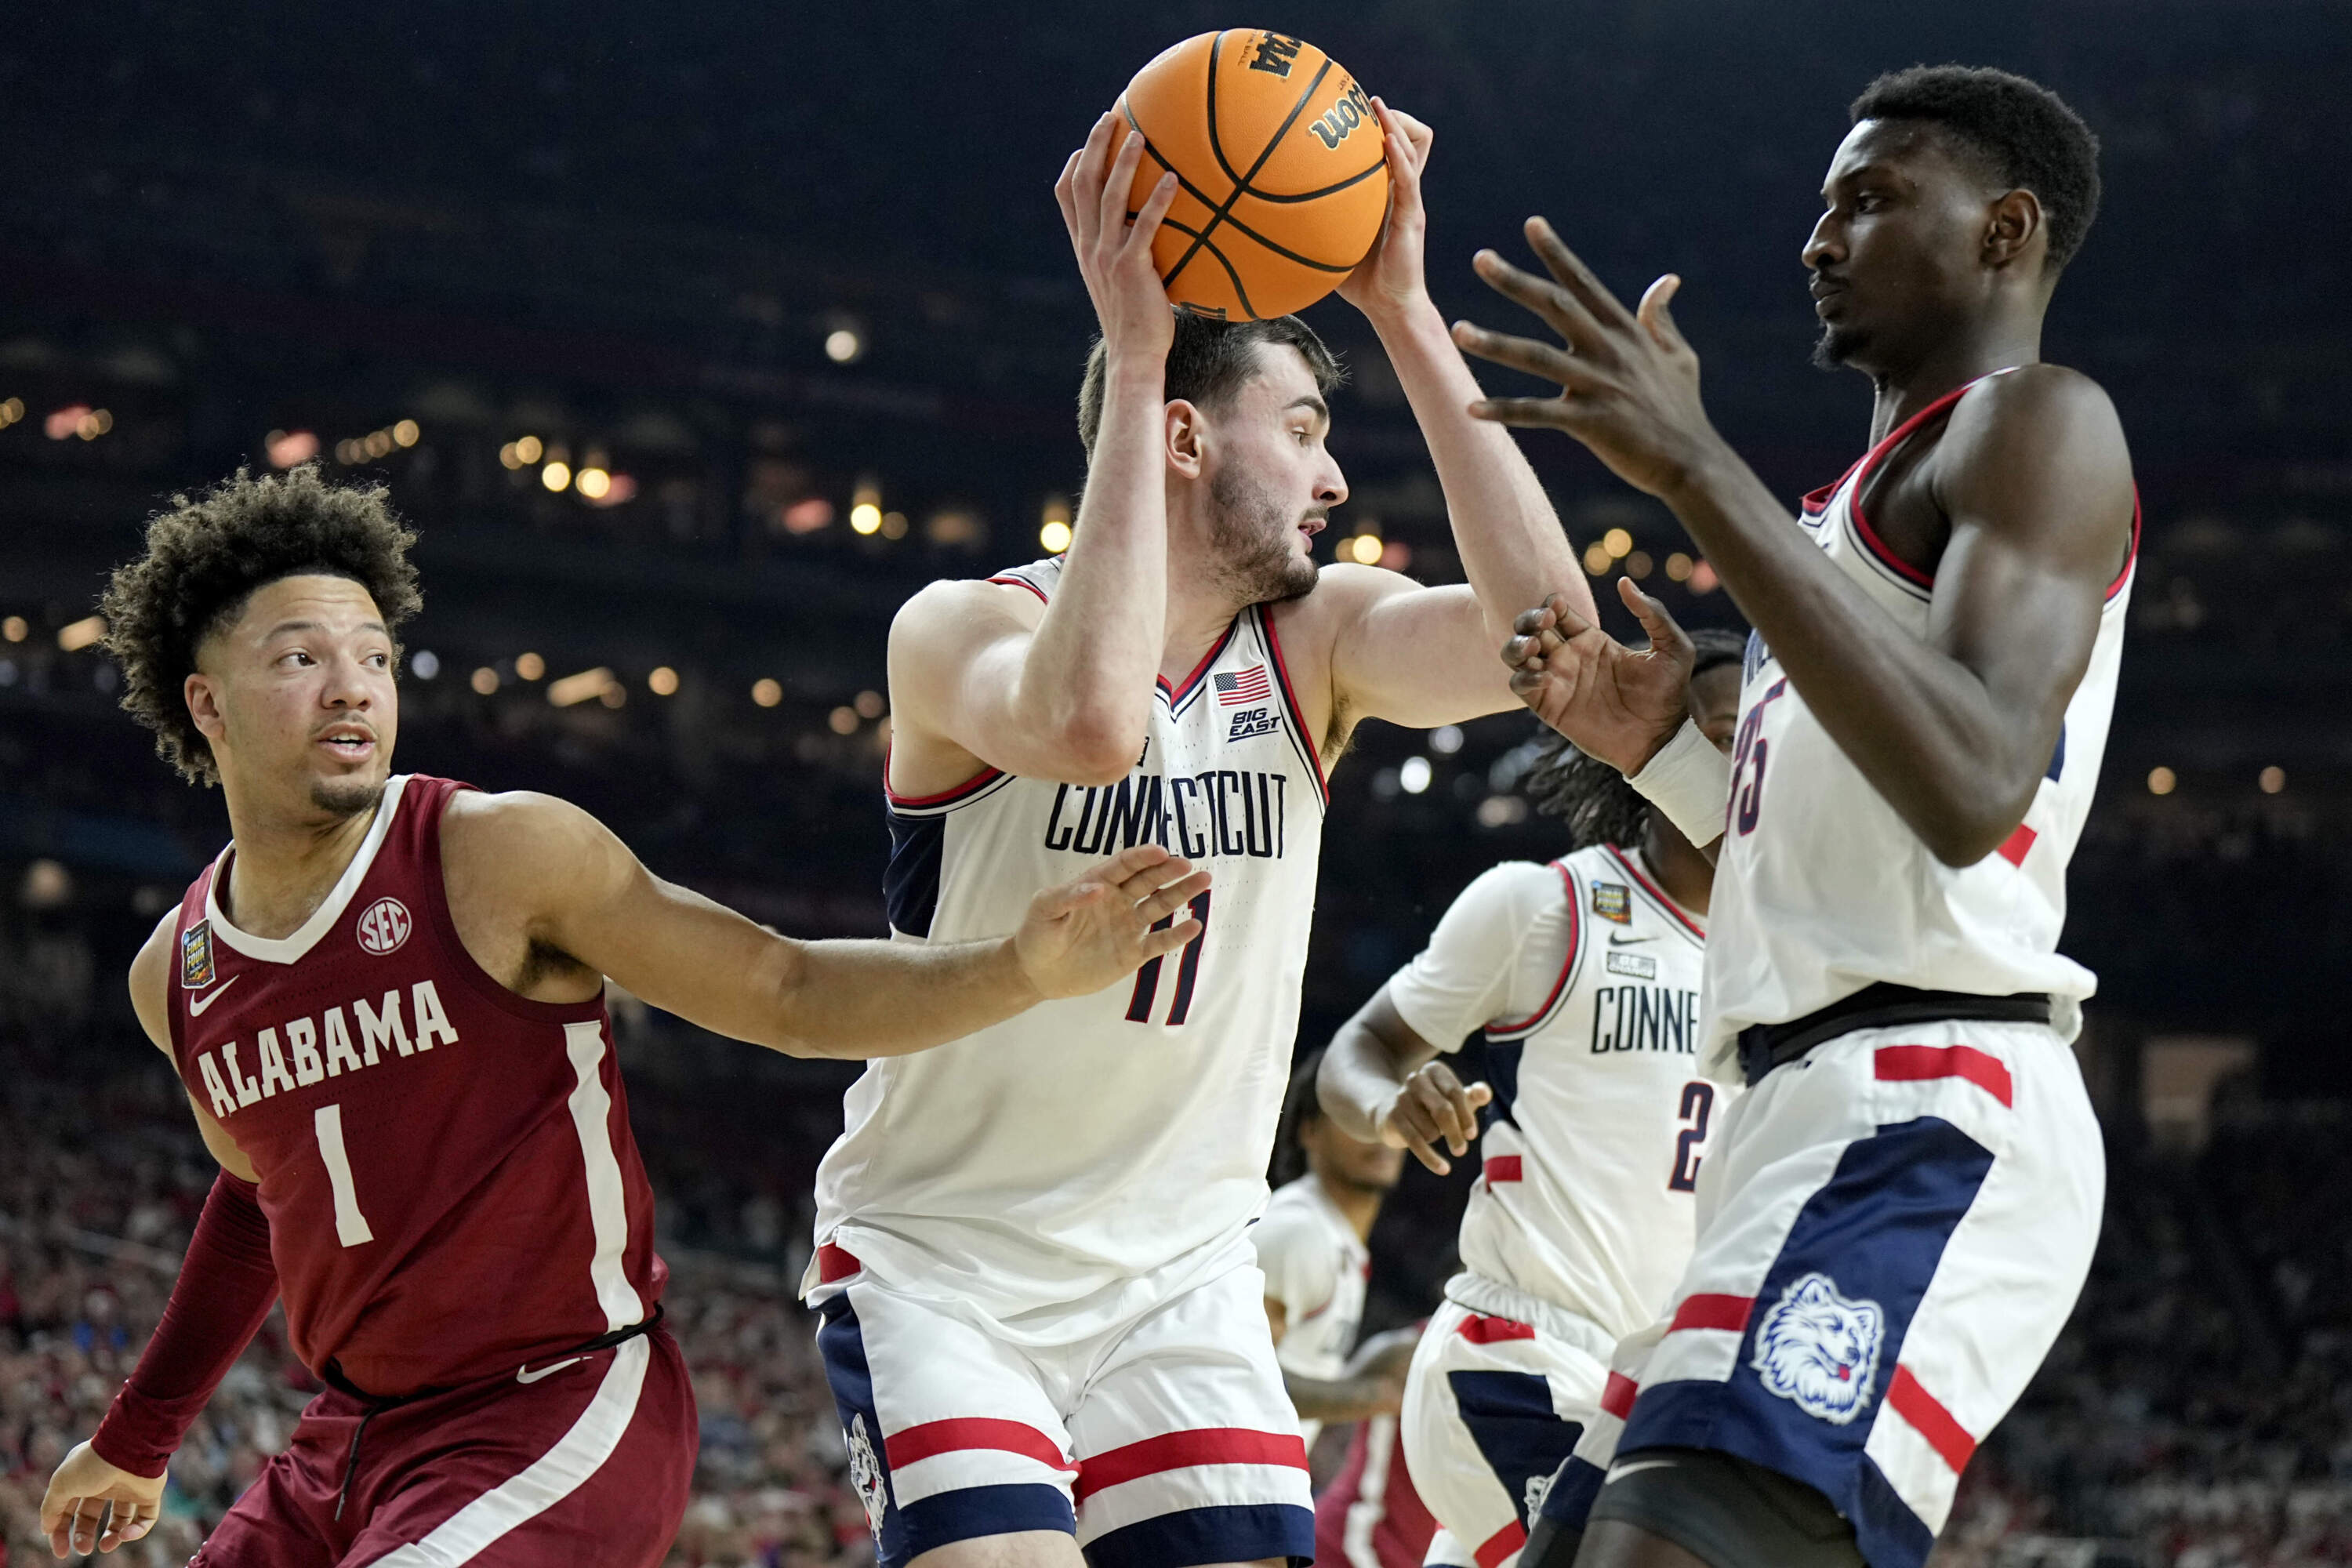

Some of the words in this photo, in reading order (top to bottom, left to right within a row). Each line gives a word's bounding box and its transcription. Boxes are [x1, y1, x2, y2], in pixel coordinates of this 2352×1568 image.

[1229, 716, 1281, 736] EAST
[1232, 707, 1268, 724] BIG
[186, 932, 205, 957] FINAL
[361, 901, 408, 951] SEC
[186, 946, 205, 972] FOUR
[1125, 888, 1212, 1025] 11
[198, 979, 459, 1119] ALABAMA
[1668, 1081, 1714, 1193] 2
[314, 1103, 375, 1248] 1
